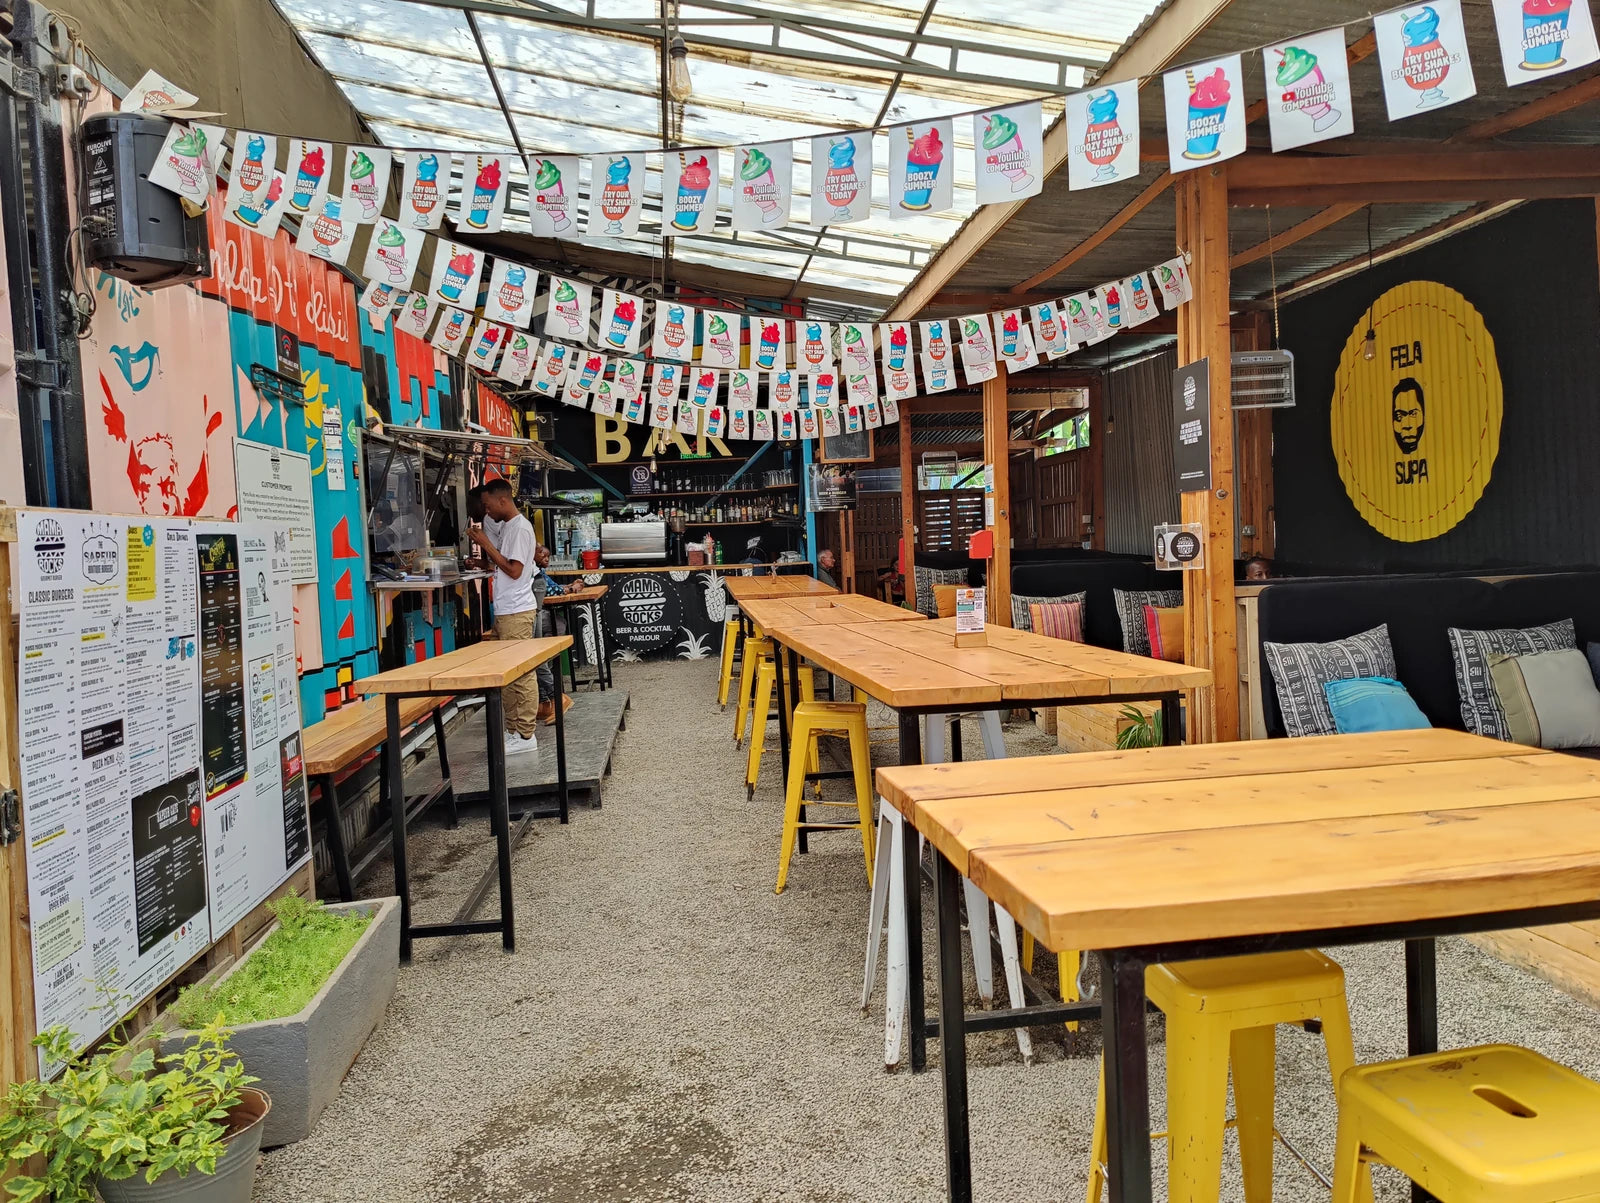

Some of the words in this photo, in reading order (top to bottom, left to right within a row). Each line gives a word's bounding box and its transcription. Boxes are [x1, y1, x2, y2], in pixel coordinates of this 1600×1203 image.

[1525, 20, 1562, 39] BOOZY
[1521, 30, 1569, 51] SUMMER
[1404, 51, 1423, 65] TRY
[1424, 48, 1443, 62] OUR
[1392, 65, 1423, 80] BOOZY
[1424, 53, 1461, 72] SHAKES
[1412, 69, 1443, 84] TODAY
[1295, 82, 1333, 100] YouTube
[1282, 93, 1336, 113] COMPETITION
[1190, 114, 1220, 129] BOOZY
[1086, 130, 1101, 141] TRY
[1103, 127, 1120, 138] OUR
[1186, 124, 1225, 140] SUMMER
[87, 140, 112, 151] EUROLIVE
[1075, 141, 1101, 154] BOOZY
[1103, 134, 1132, 147] SHAKES
[997, 150, 1029, 162] YouTube
[1091, 146, 1116, 159] TODAY
[178, 159, 204, 178] YouTube
[242, 164, 252, 172] TRY
[252, 165, 264, 174] OUR
[986, 160, 1031, 173] COMPETITION
[166, 161, 202, 184] COMPETITION
[841, 174, 855, 182] OUR
[907, 171, 933, 182] BOOZY
[242, 178, 259, 186] TODAY
[297, 179, 315, 187] BOOZY
[817, 184, 839, 193] BOOZY
[840, 181, 866, 191] SHAKES
[903, 180, 937, 191] SUMMER
[293, 186, 317, 195] SUMMER
[425, 186, 436, 194] OUR
[752, 184, 780, 194] YouTube
[474, 195, 491, 203] BOOZY
[545, 194, 569, 203] YouTube
[679, 196, 701, 204] BOOZY
[743, 192, 781, 202] COMPETITION
[830, 191, 851, 199] TODAY
[471, 202, 493, 211] SUMMER
[536, 203, 569, 211] COMPETITION
[595, 198, 614, 206] BOOZY
[615, 198, 638, 206] SHAKES
[606, 206, 625, 214] TODAY
[675, 204, 704, 212] SUMMER
[317, 220, 328, 229] TRY
[328, 223, 340, 232] OUR
[317, 233, 336, 243] TODAY
[385, 252, 408, 264] YouTube
[446, 274, 466, 284] BOOZY
[442, 280, 467, 290] SUMMER
[512, 289, 523, 297] OUR
[502, 300, 519, 308] TODAY
[613, 322, 629, 330] BOOZY
[1391, 341, 1422, 370] FELA
[594, 411, 733, 464] BAR
[1395, 459, 1429, 484] SUPA
[261, 481, 278, 490] CUSTOMER
[36, 519, 64, 536] MAMA
[37, 558, 64, 574] ROCKS
[622, 578, 662, 593] MAMA
[28, 590, 50, 603] CLASSIC
[51, 588, 74, 602] BURGERS
[623, 611, 663, 624] ROCKS
[640, 625, 672, 633] COCKTAIL
